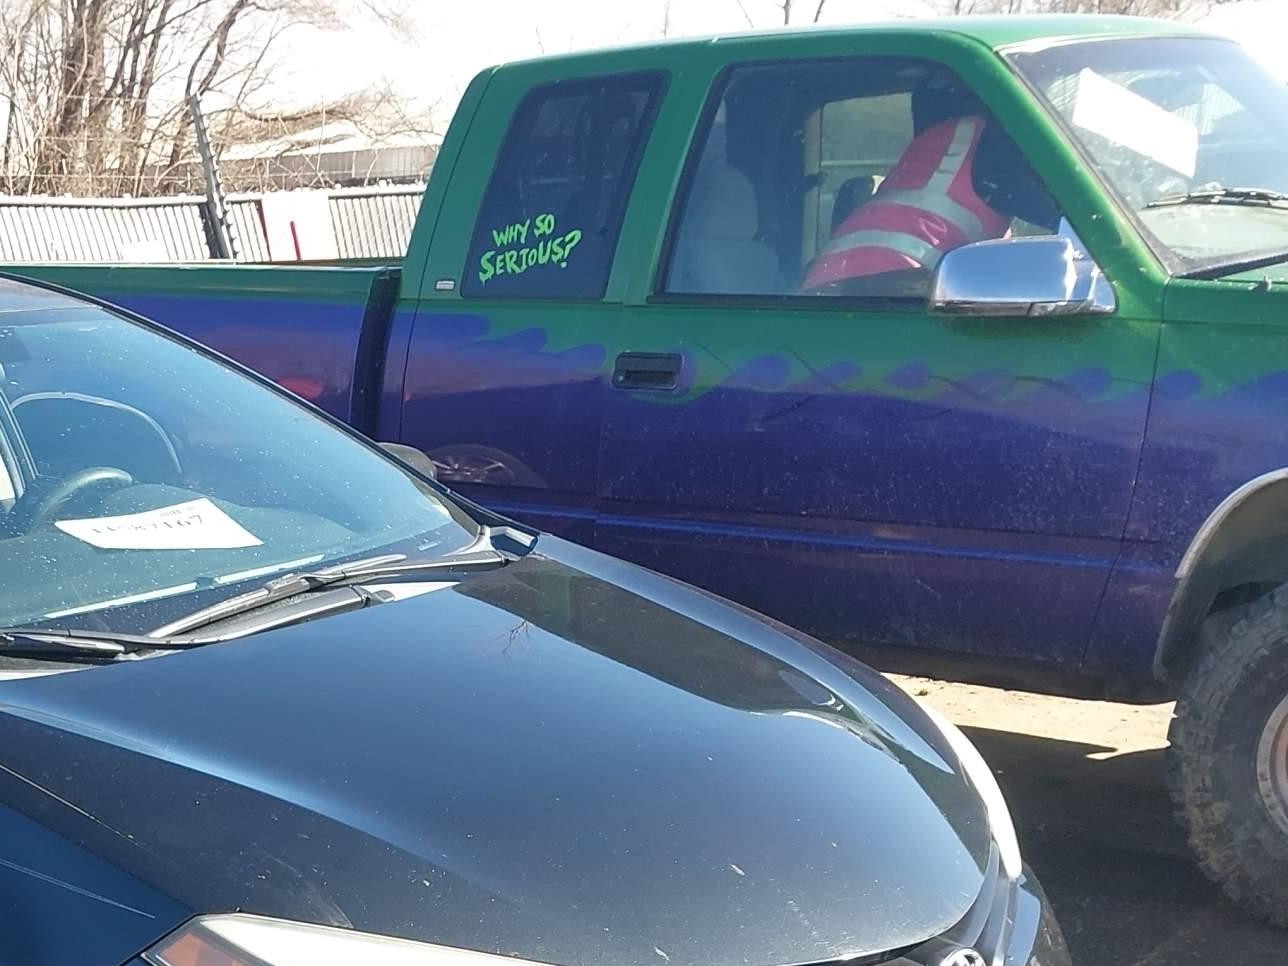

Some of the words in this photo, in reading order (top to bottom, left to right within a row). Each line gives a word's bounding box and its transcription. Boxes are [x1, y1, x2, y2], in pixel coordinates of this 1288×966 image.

[492, 219, 530, 247] WHY
[533, 214, 555, 237] SO
[478, 230, 582, 286] SERIOUS?
